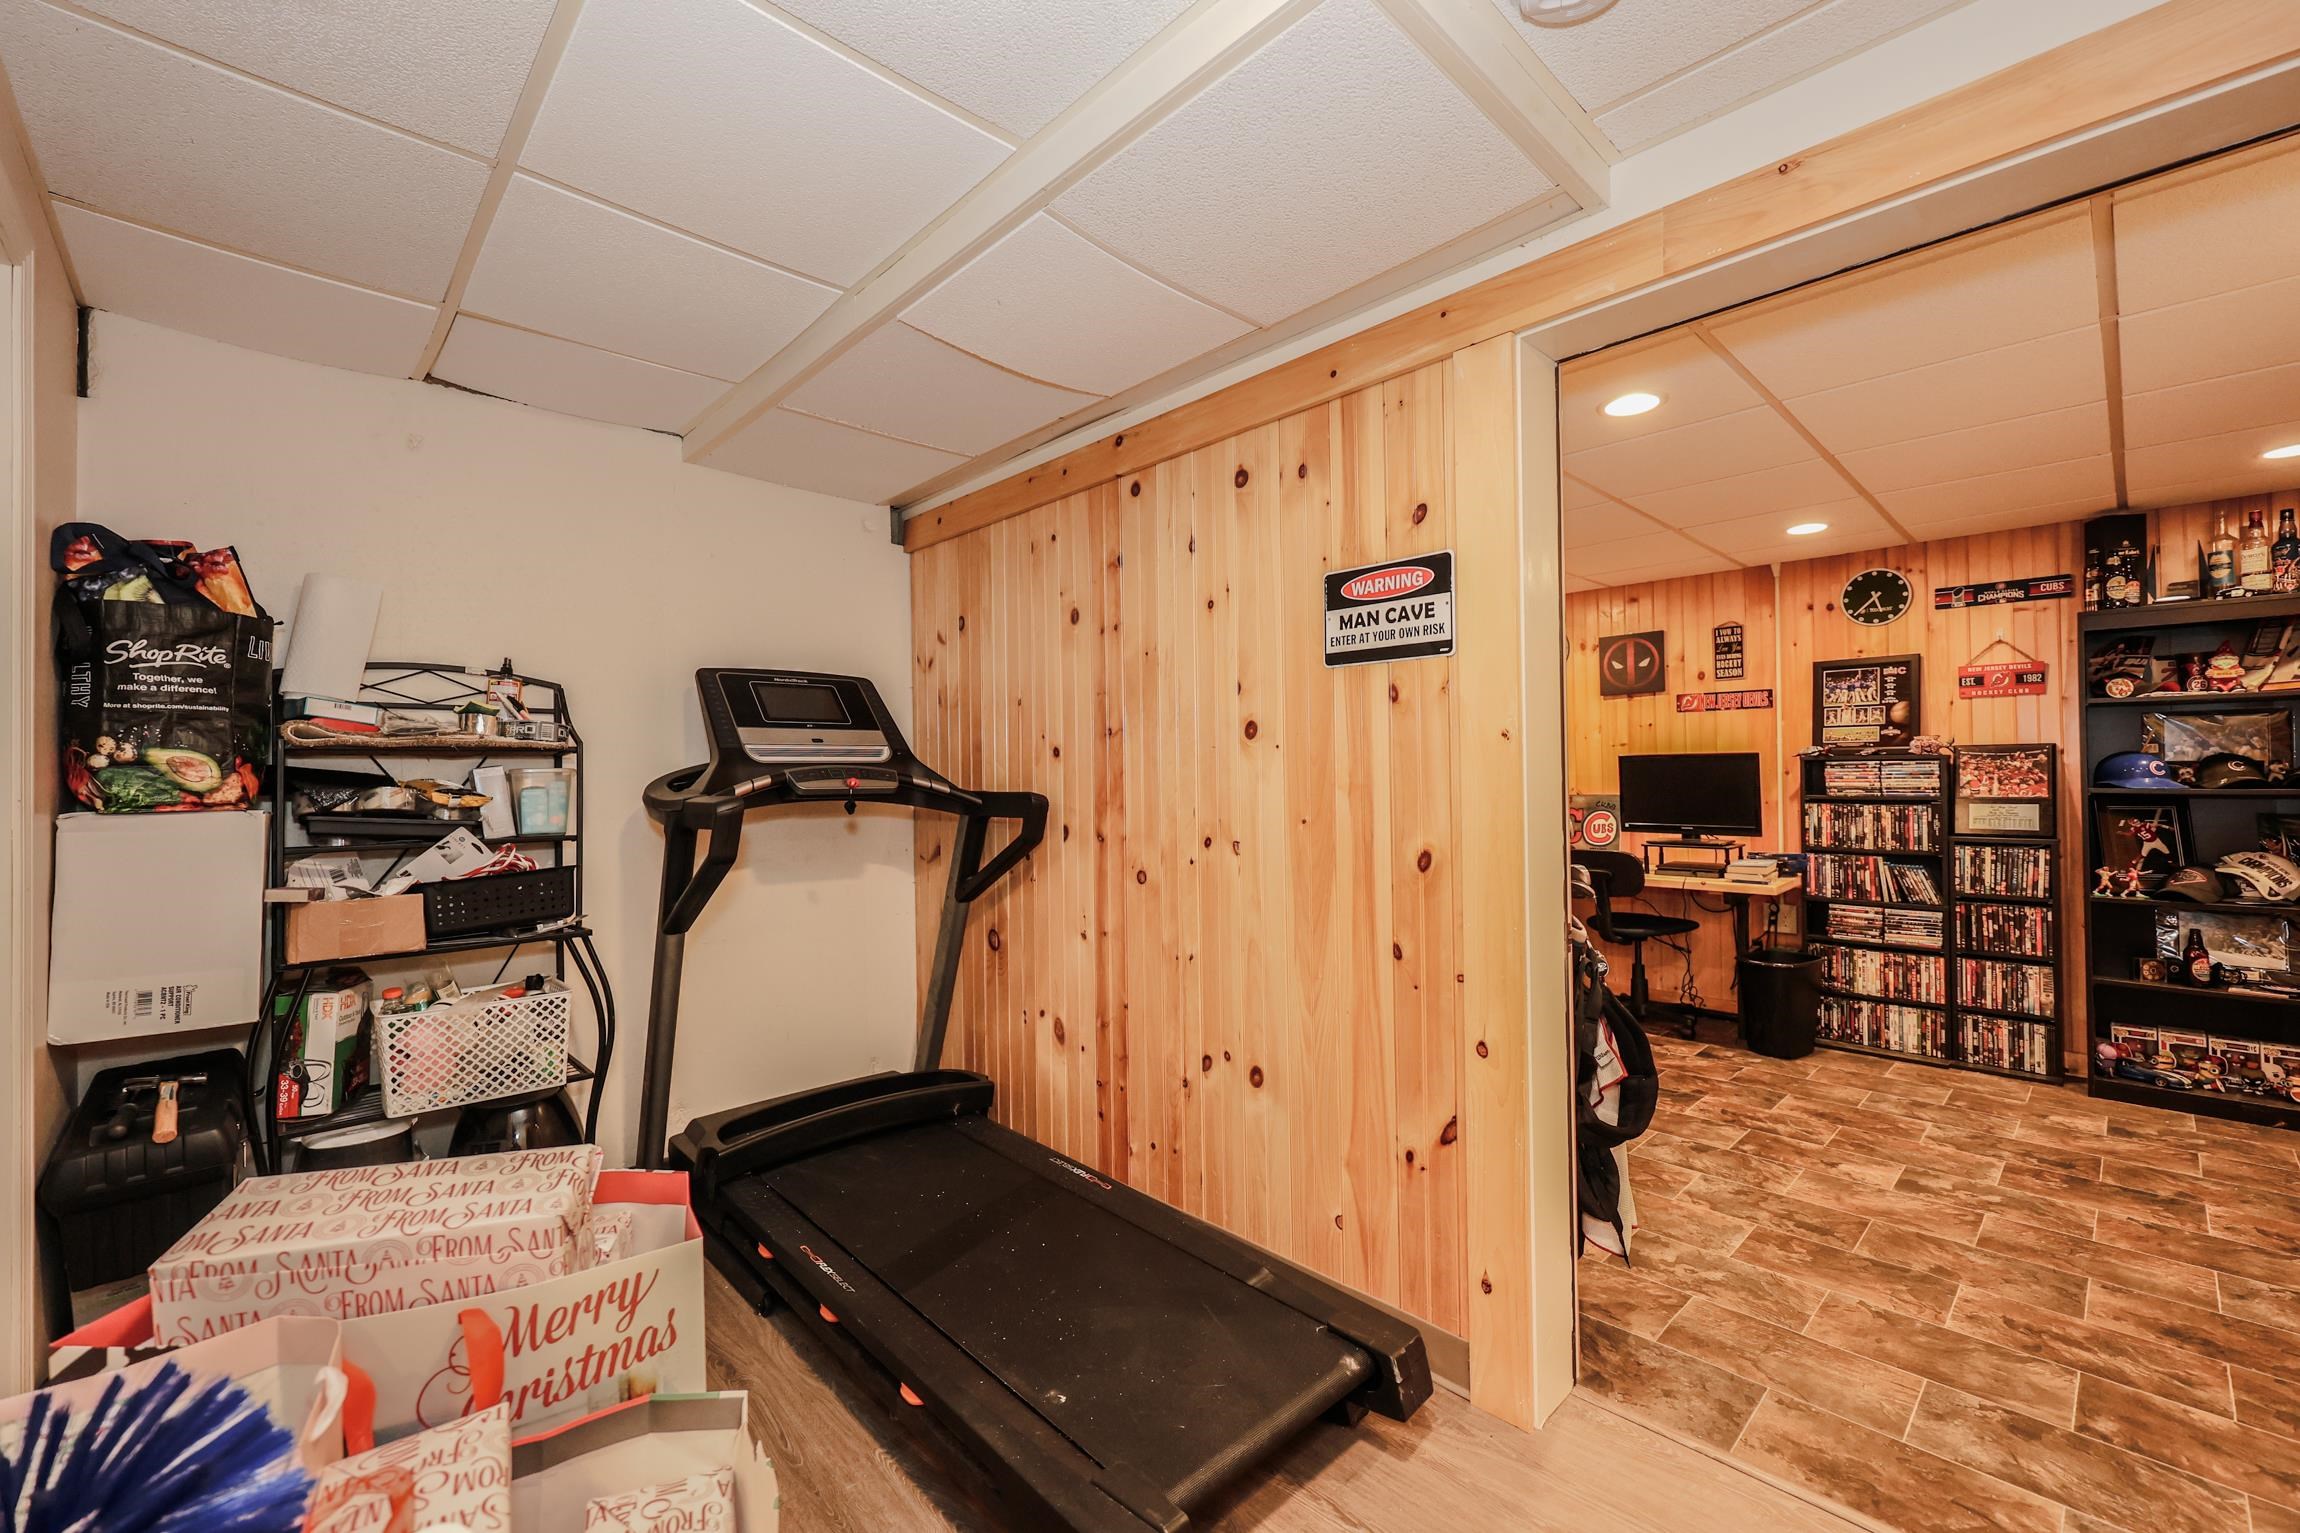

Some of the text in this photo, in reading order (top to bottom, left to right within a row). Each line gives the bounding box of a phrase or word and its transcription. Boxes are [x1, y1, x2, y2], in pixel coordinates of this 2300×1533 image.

[1351, 571, 1424, 597] WARNING
[1977, 590, 2025, 603] CHAMPIONS
[2040, 581, 2065, 592] CUBS
[1339, 601, 1436, 631] MAN CAVE
[1330, 622, 1446, 648] ENTER AT YOUR OWN RISK
[1716, 635, 1742, 644] ALWAYS
[1720, 628, 1732, 636] VOW
[1733, 627, 1742, 635] TO
[103, 639, 231, 668] ShopRite
[1716, 659, 1742, 669] HOCKEY
[132, 672, 204, 684] Together, we
[1716, 668, 1743, 678] SEASON
[1961, 677, 1976, 686] EST.
[2023, 673, 2043, 683] 1982
[2193, 680, 2207, 690] 26
[117, 683, 149, 692] make
[160, 683, 217, 695] difference!
[1742, 691, 1769, 708] DEVILS
[132, 702, 230, 713] shoprite.com/sustainability
[174, 994, 182, 1025] CONDITIONER
[321, 996, 334, 1020] HDX
[279, 1080, 289, 1102] 33-39
[500, 1150, 574, 1175] FROM
[290, 1160, 460, 1195] FROM SANTA
[537, 1167, 586, 1197] FRO
[322, 1179, 494, 1216] FROM SANTA
[357, 1197, 532, 1239] FROM SANTA
[206, 1221, 314, 1255] SANTA
[493, 1226, 568, 1264] SANT
[148, 1268, 198, 1304] NTA
[324, 1272, 498, 1321] FROM SANTA
[502, 1267, 660, 1358] Merry
[168, 1309, 263, 1346] SANTA
[452, 1456, 510, 1497] ROM
